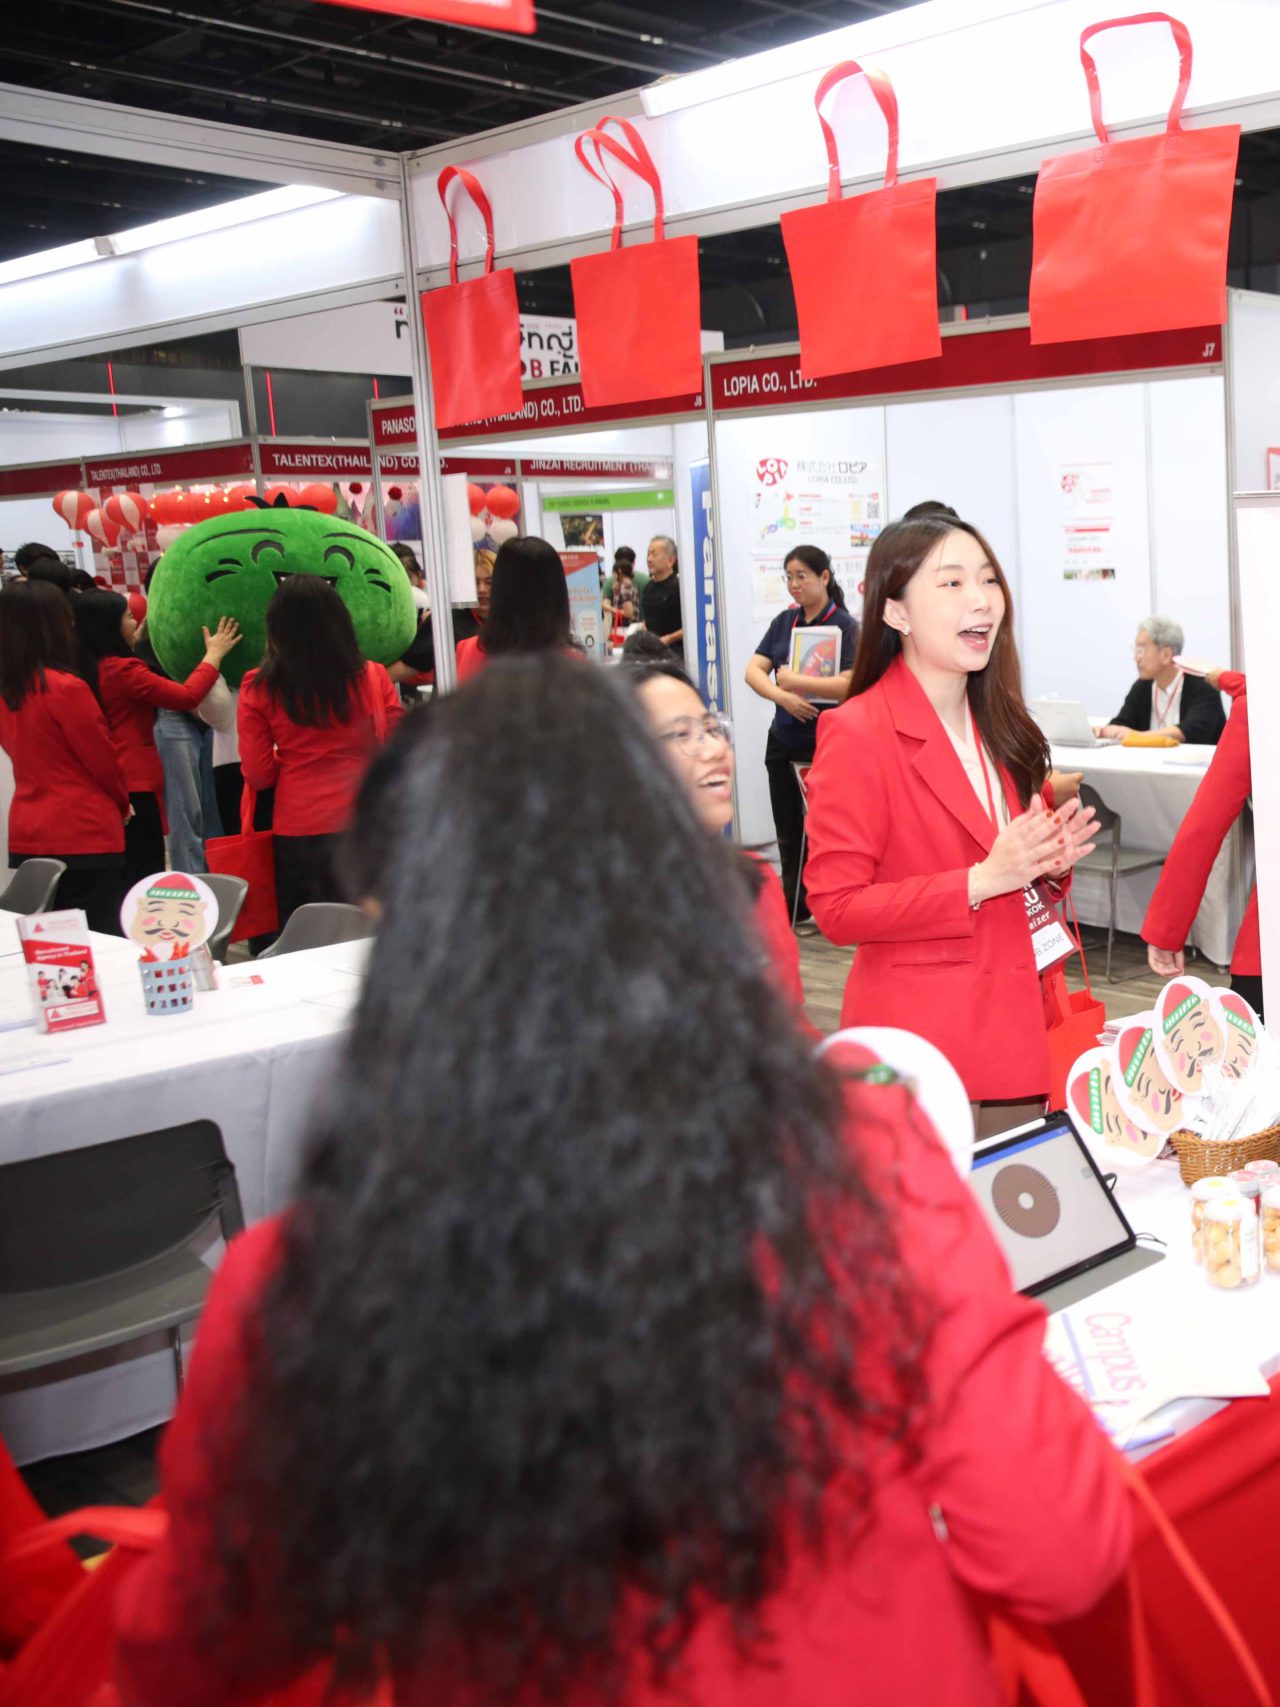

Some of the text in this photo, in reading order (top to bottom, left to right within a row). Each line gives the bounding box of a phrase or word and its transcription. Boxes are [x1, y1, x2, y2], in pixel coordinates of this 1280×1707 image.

[1202, 342, 1215, 357] J7
[723, 374, 760, 397] LOPIA
[762, 371, 787, 394] CO.,
[540, 398, 560, 417] CO.,
[562, 395, 584, 414] LTD.
[381, 417, 418, 436] PANASO
[272, 453, 398, 470] TALENTEX(THAILND)
[564, 459, 627, 472] RECRUITMENT
[1084, 1312, 1147, 1392] Campus
